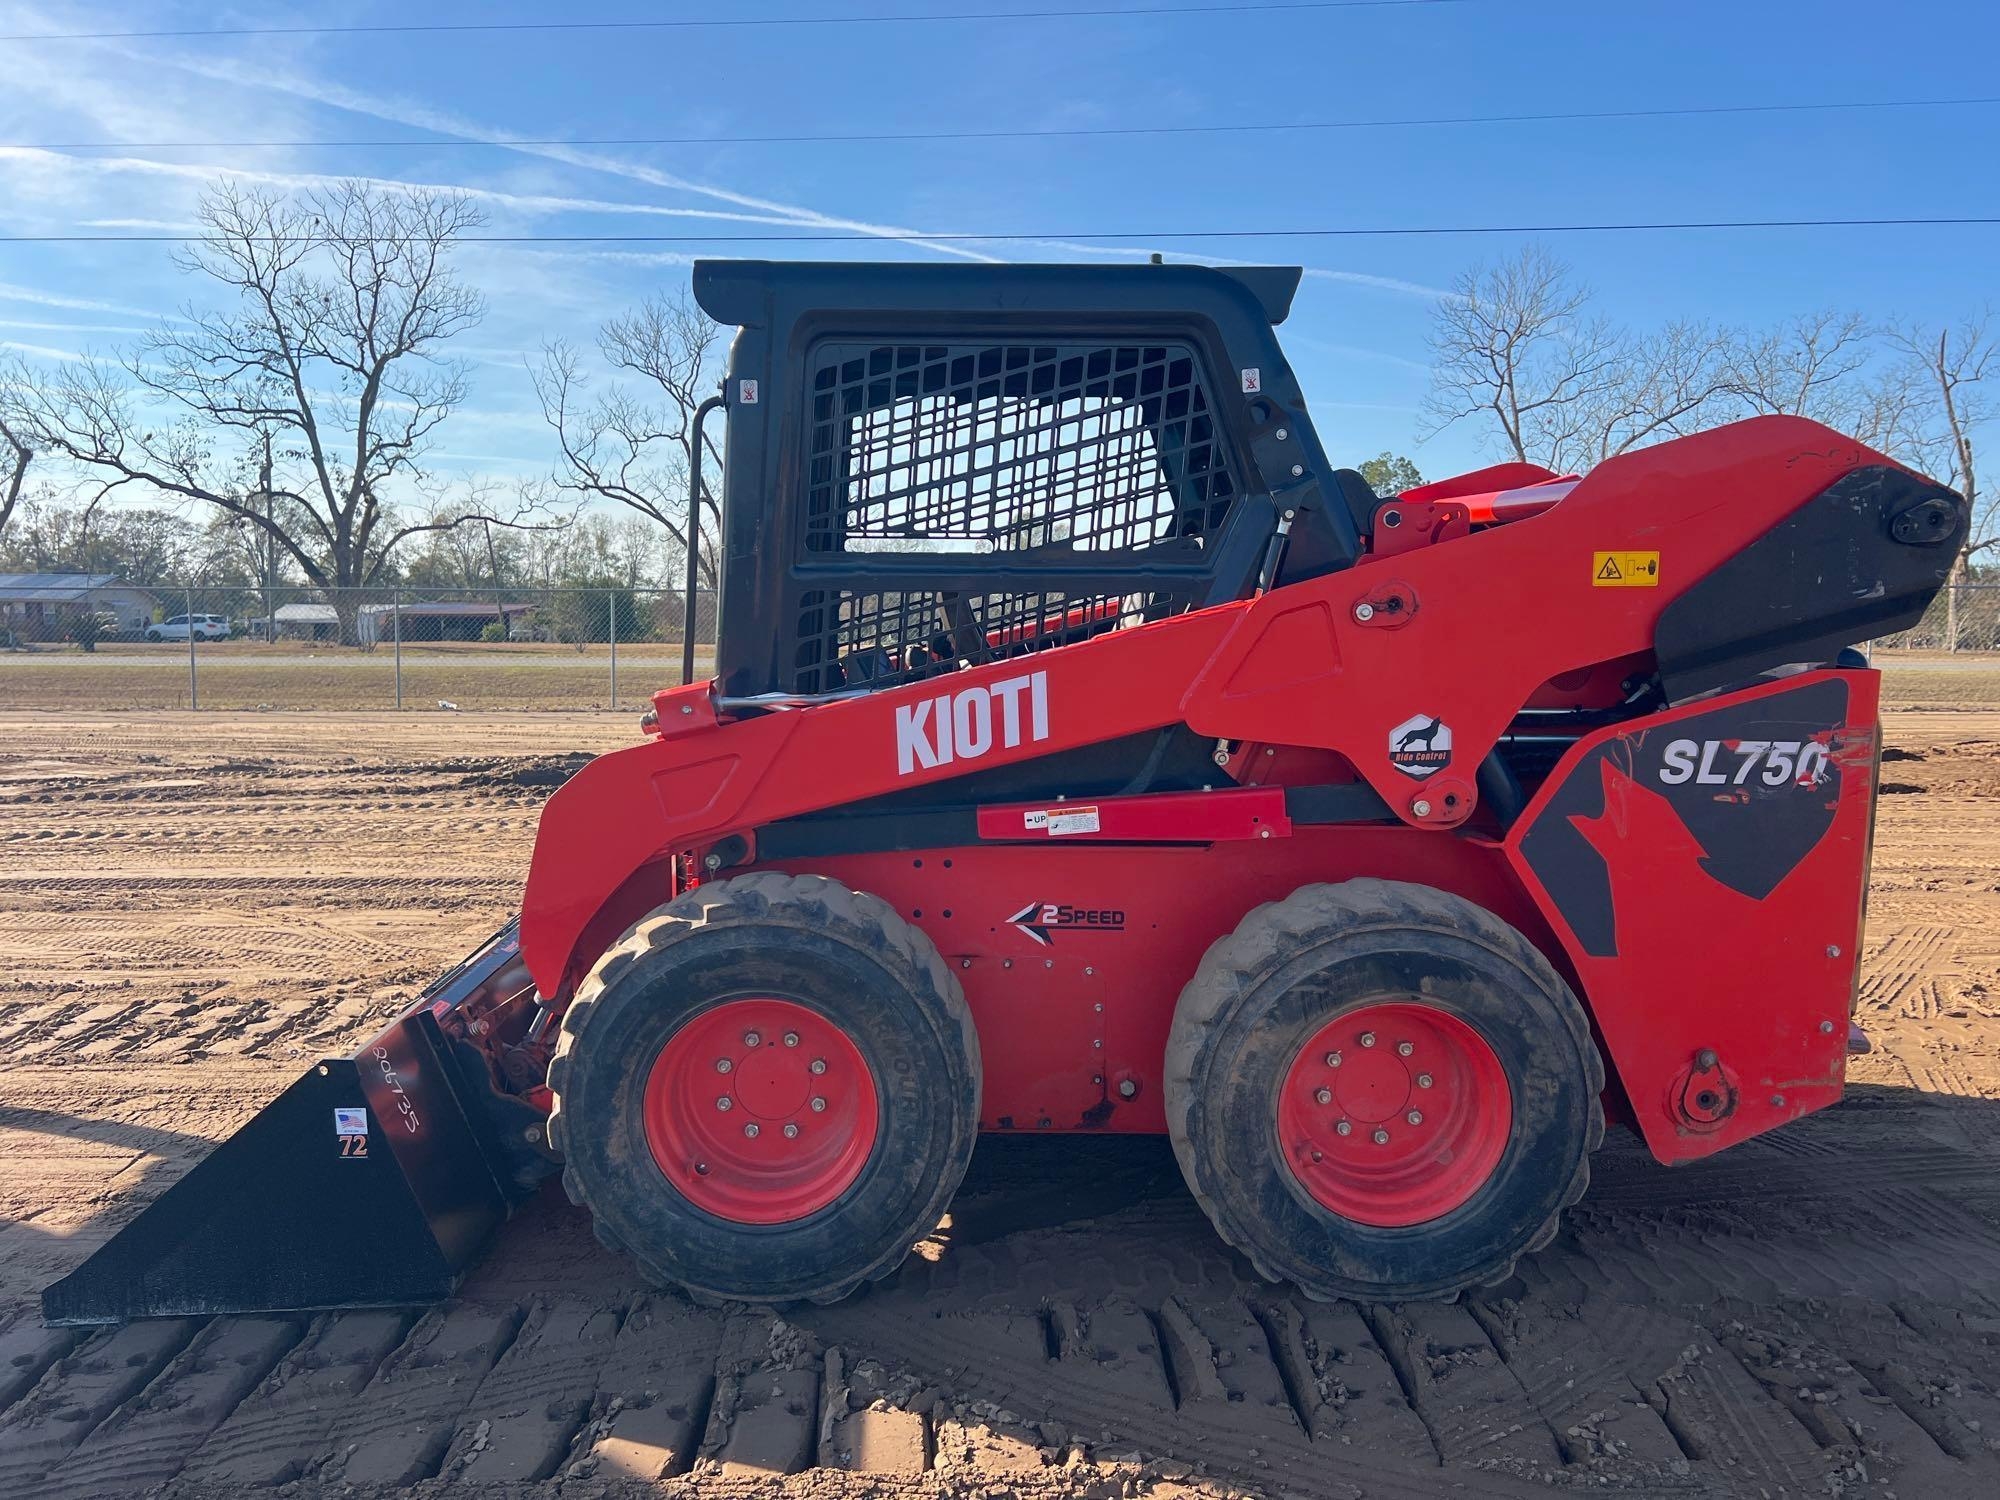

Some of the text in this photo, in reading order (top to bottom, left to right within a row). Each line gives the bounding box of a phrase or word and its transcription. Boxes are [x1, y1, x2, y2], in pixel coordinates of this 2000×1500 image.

[896, 671, 1048, 775] KIOTI
[1396, 752, 1446, 761] Ride Control
[1659, 739, 1831, 786] SL750
[1034, 815, 1046, 823] UP
[373, 1047, 420, 1133] 206735
[339, 1135, 368, 1156] 72
